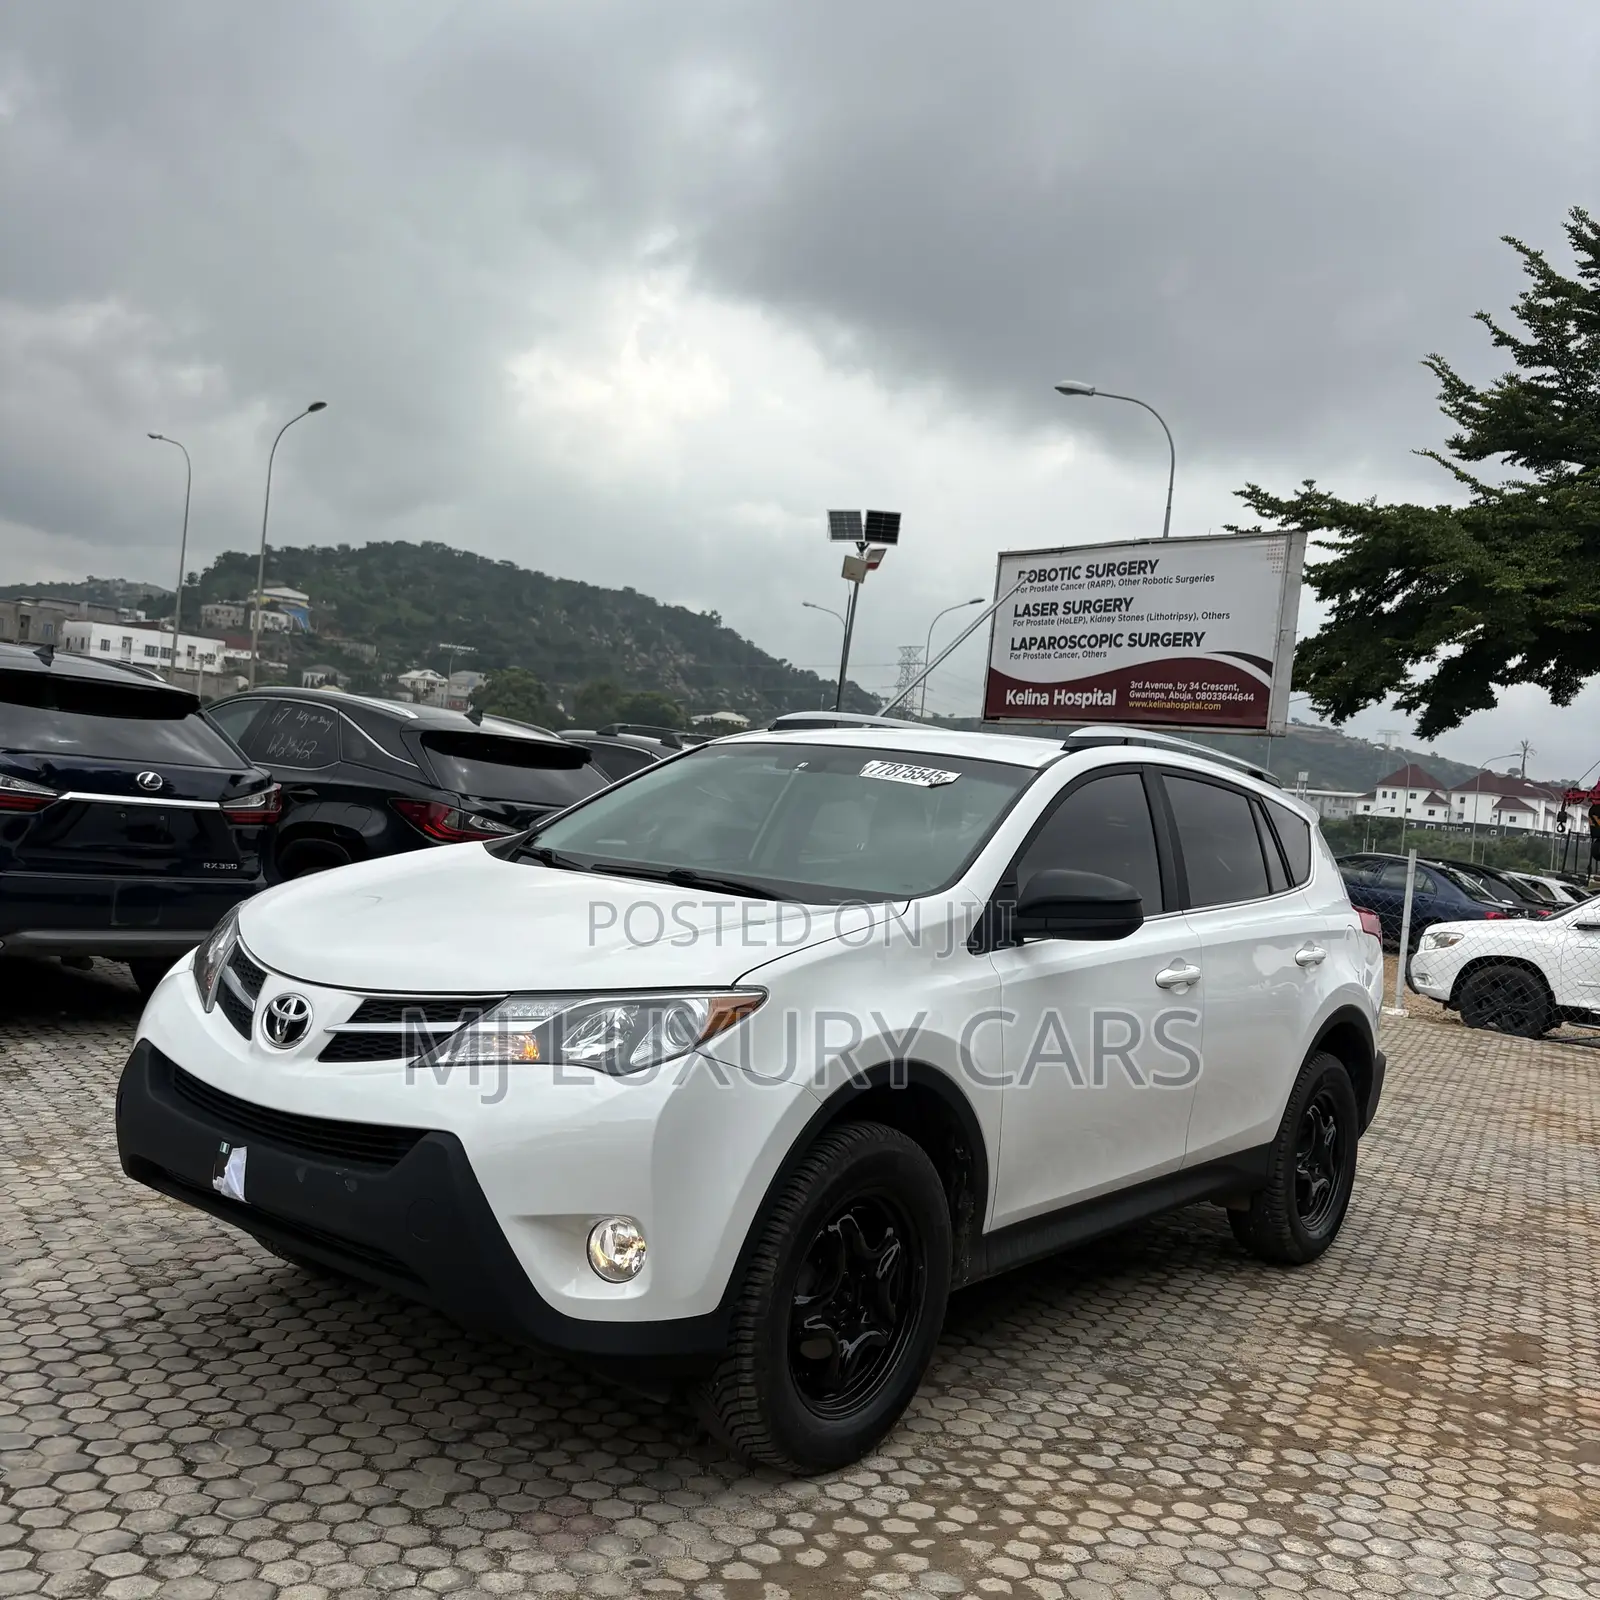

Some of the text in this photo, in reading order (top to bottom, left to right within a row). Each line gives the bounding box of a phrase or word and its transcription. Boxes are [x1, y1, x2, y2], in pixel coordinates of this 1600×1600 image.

[1085, 559, 1160, 579] SURGERY
[1029, 583, 1059, 593] Prostate
[1060, 581, 1086, 591] Cancer
[1087, 579, 1116, 590] (RARP),
[1118, 578, 1141, 587] Other
[1142, 575, 1173, 585] Robotic
[1175, 573, 1215, 585] Surgeries
[1013, 597, 1134, 618] LASER SURGERY
[1012, 619, 1025, 627] For
[1025, 618, 1055, 627] Prostate
[1089, 614, 1116, 624] Kidney
[1117, 613, 1145, 622] Stones
[1146, 611, 1199, 623] (Lithotripsy),
[1201, 611, 1231, 620] Others
[1010, 631, 1206, 651] LAPAROSCOPIC SURGERY
[1009, 650, 1107, 660] For Prostate Cancer, Others
[1130, 681, 1240, 692] 3rd Avenue, by 34 Crescent,
[1005, 687, 1117, 709] Kelina Hospital
[1129, 690, 1255, 702] Gwarinpa, Abuja. 08033644644
[1128, 700, 1221, 711] www.kelinahospital.com
